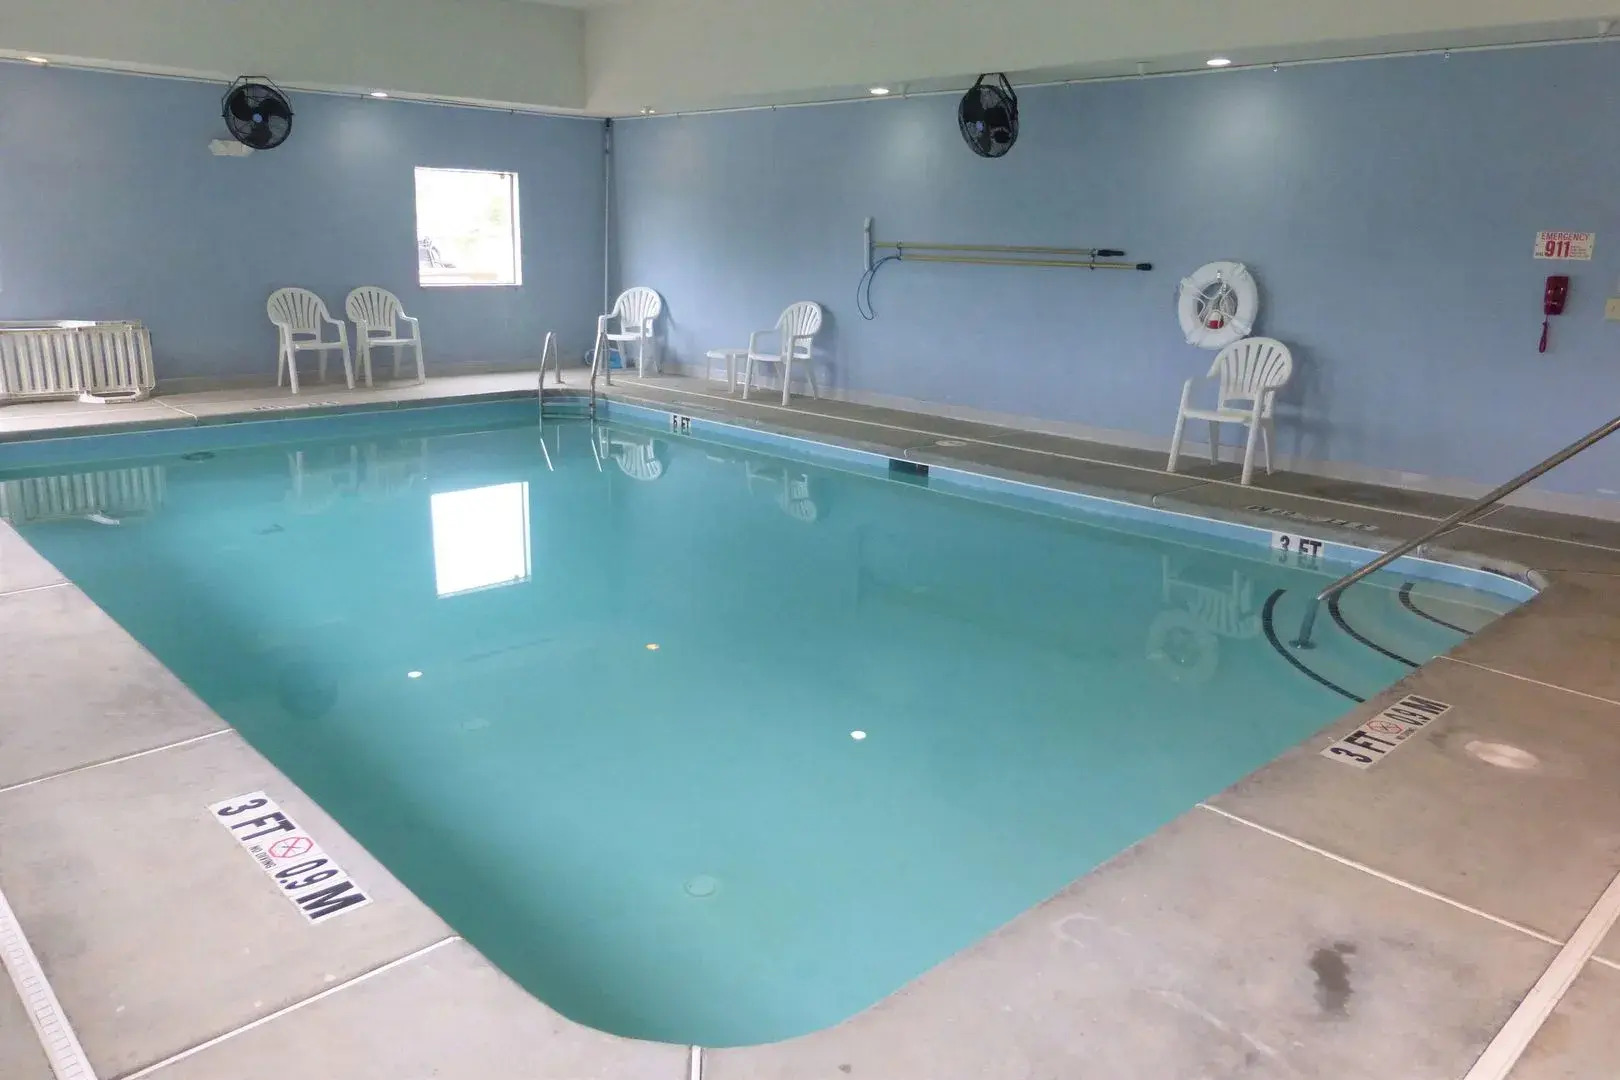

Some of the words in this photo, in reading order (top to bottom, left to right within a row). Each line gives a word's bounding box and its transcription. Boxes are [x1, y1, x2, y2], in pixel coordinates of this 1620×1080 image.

[1541, 232, 1588, 241] EMERGENCY
[1545, 240, 1570, 257] 911
[681, 416, 690, 429] FT
[1280, 535, 1290, 551] 3
[1298, 538, 1322, 556] FT
[1343, 730, 1396, 754] FT
[1330, 747, 1373, 763] 3
[217, 798, 268, 816] 3
[231, 811, 296, 841] FT
